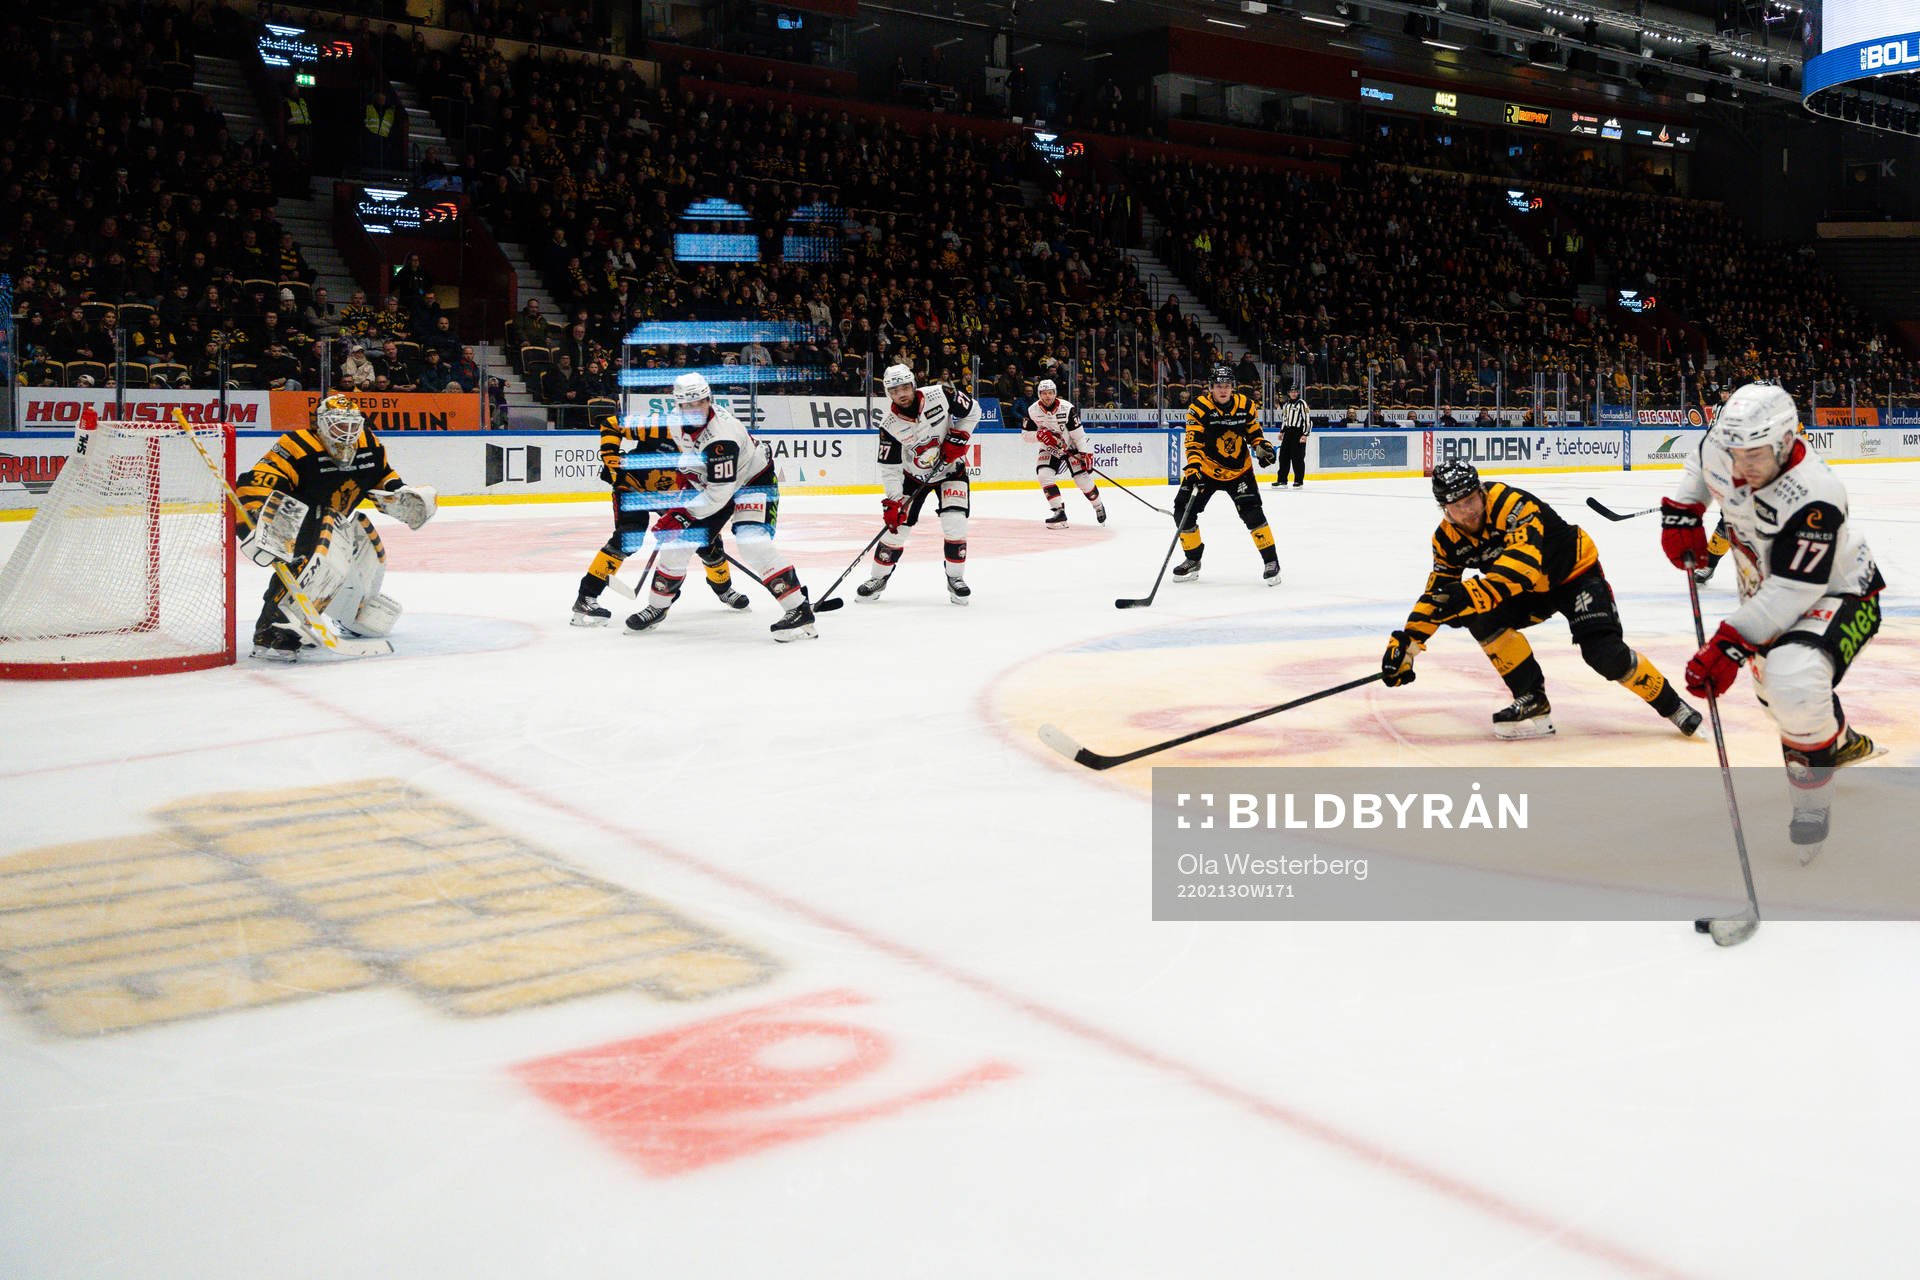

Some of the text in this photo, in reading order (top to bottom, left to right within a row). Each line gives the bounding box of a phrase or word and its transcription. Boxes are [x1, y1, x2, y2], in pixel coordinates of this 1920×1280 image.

[1868, 40, 1920, 70] BOL
[382, 398, 399, 408] BY
[1638, 410, 1657, 424] BIG
[1094, 442, 1143, 454] Skellefteå
[1171, 434, 1179, 477] CCM
[1342, 448, 1386, 463] BJURFORS
[1425, 430, 1434, 469] CCM
[1443, 437, 1531, 461] BOLIDEN
[1555, 437, 1621, 459] tietoevry
[713, 460, 734, 479] 90
[1093, 457, 1119, 467] Kraft
[250, 471, 278, 486] 30
[943, 488, 967, 497] MAXI
[1789, 538, 1830, 574] 17
[1465, 581, 1487, 609] CCM
